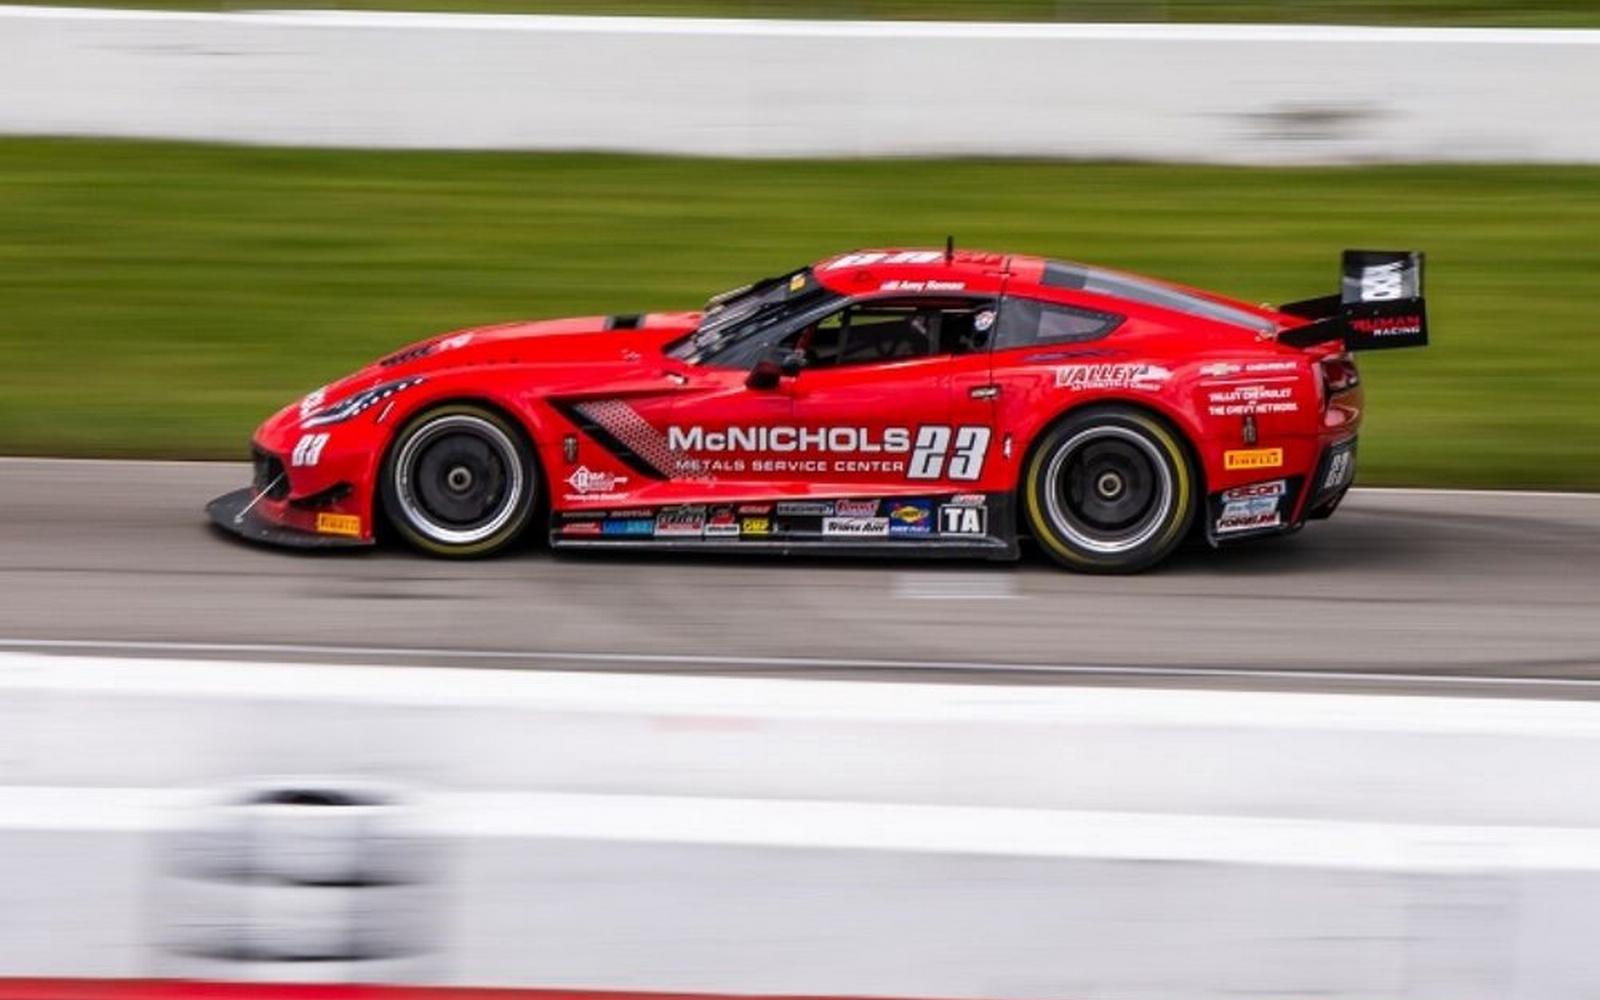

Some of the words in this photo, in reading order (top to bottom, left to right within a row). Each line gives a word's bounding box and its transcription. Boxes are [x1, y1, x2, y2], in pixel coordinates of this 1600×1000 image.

[1373, 327, 1420, 336] RACING
[1058, 364, 1139, 384] VALLEY
[668, 426, 910, 452] McNICHOLS
[907, 425, 991, 480] 23
[1228, 452, 1279, 466] PIRELLI
[676, 459, 745, 472] METALS
[752, 459, 827, 472] SERVICE
[834, 460, 905, 472] CENTER
[944, 507, 980, 532] TA
